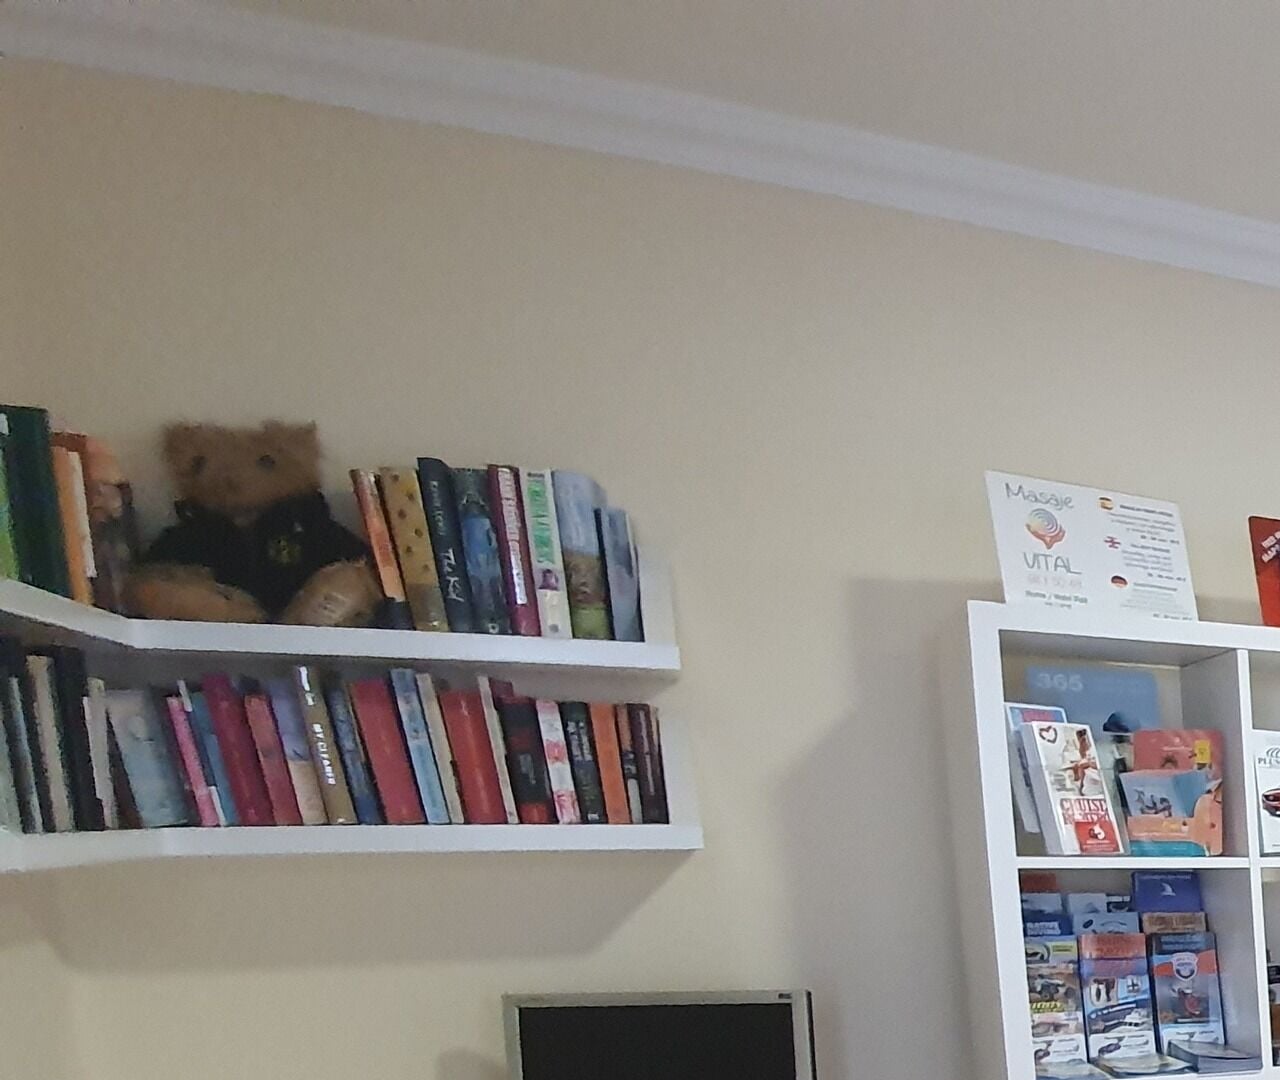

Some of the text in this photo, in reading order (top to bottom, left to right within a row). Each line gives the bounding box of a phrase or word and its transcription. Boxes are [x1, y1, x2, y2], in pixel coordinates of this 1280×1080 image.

[1005, 482, 1074, 511] Masaje
[440, 547, 464, 603] The Kid
[1023, 552, 1082, 575] VITAL
[1037, 672, 1083, 692] 365
[1257, 757, 1280, 766] PLUS
